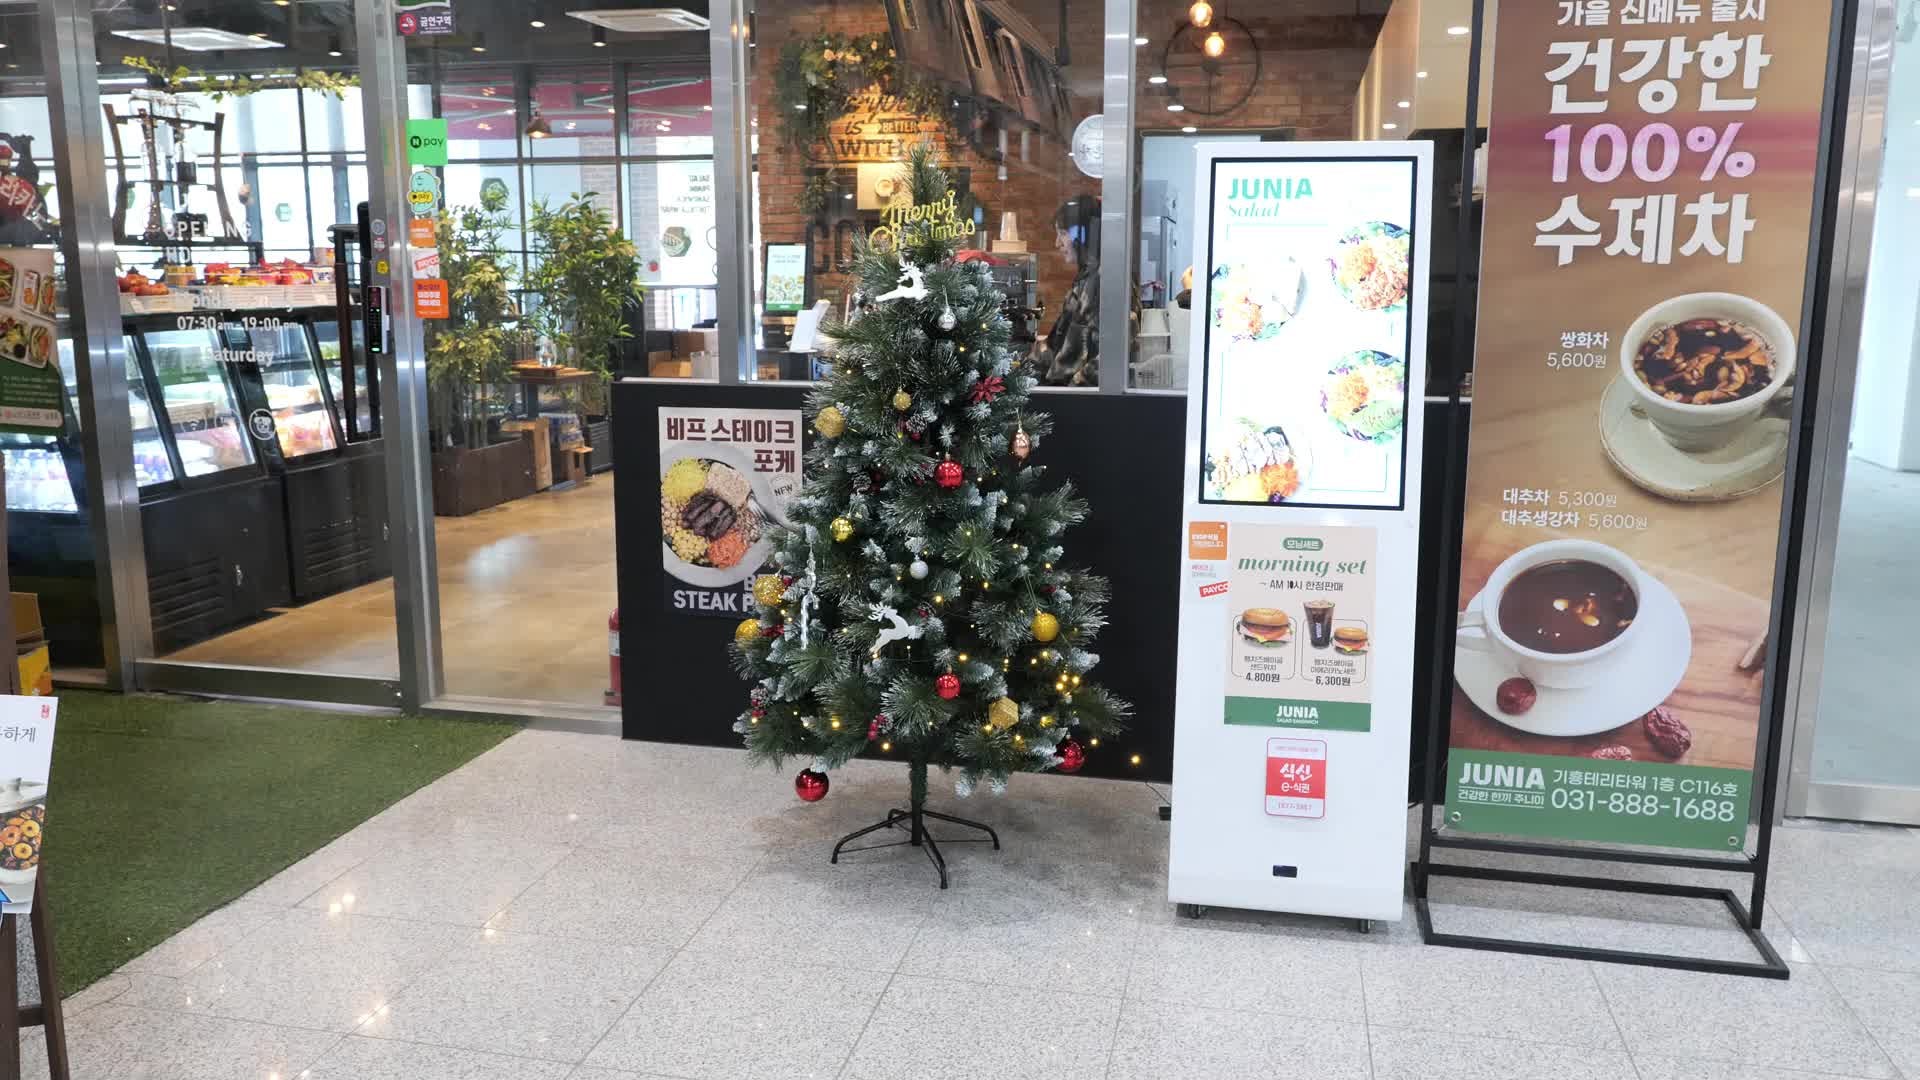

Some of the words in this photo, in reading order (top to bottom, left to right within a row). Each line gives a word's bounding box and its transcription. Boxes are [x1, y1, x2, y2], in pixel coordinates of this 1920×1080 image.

[420, 15, 451, 28] 금연구역
[1557, 0, 1610, 26] 가을
[1620, 0, 1702, 25] 신메뉴
[1711, 0, 1766, 22] 출시
[1544, 31, 1773, 114] 건강한
[1544, 122, 1756, 183] 100%
[1228, 177, 1313, 200] JUNIA
[881, 189, 957, 225] Merry
[1228, 202, 1280, 217] Salad
[1534, 192, 1757, 267] 수제차
[1560, 331, 1609, 349] 쌍화차
[207, 346, 273, 367] Saturday
[1546, 352, 1607, 370] 5,600원
[666, 417, 706, 441] 비프
[711, 418, 795, 443] 스테이크
[753, 449, 795, 473] 포케
[1503, 487, 1550, 506] 대추차
[1558, 490, 1616, 508] 5,300원
[1501, 508, 1580, 528] 대추생강차
[1588, 512, 1648, 530] 5,600원
[1286, 539, 1320, 550] 모닝세트
[1238, 555, 1330, 578] morning
[1335, 559, 1367, 575] set
[1202, 583, 1231, 596] PAYCO
[1269, 579, 1284, 590] AM
[1305, 580, 1344, 592] 한정판매
[673, 590, 738, 612] STEAK
[1315, 675, 1351, 687] 6,300원
[1276, 704, 1319, 719] JUNIA
[1280, 763, 1313, 781] 식신
[1458, 762, 1545, 790] JUNIA
[1651, 776, 1675, 792] 1층
[1680, 779, 1738, 798] C116호
[1551, 787, 1735, 823] 031-888-1688
